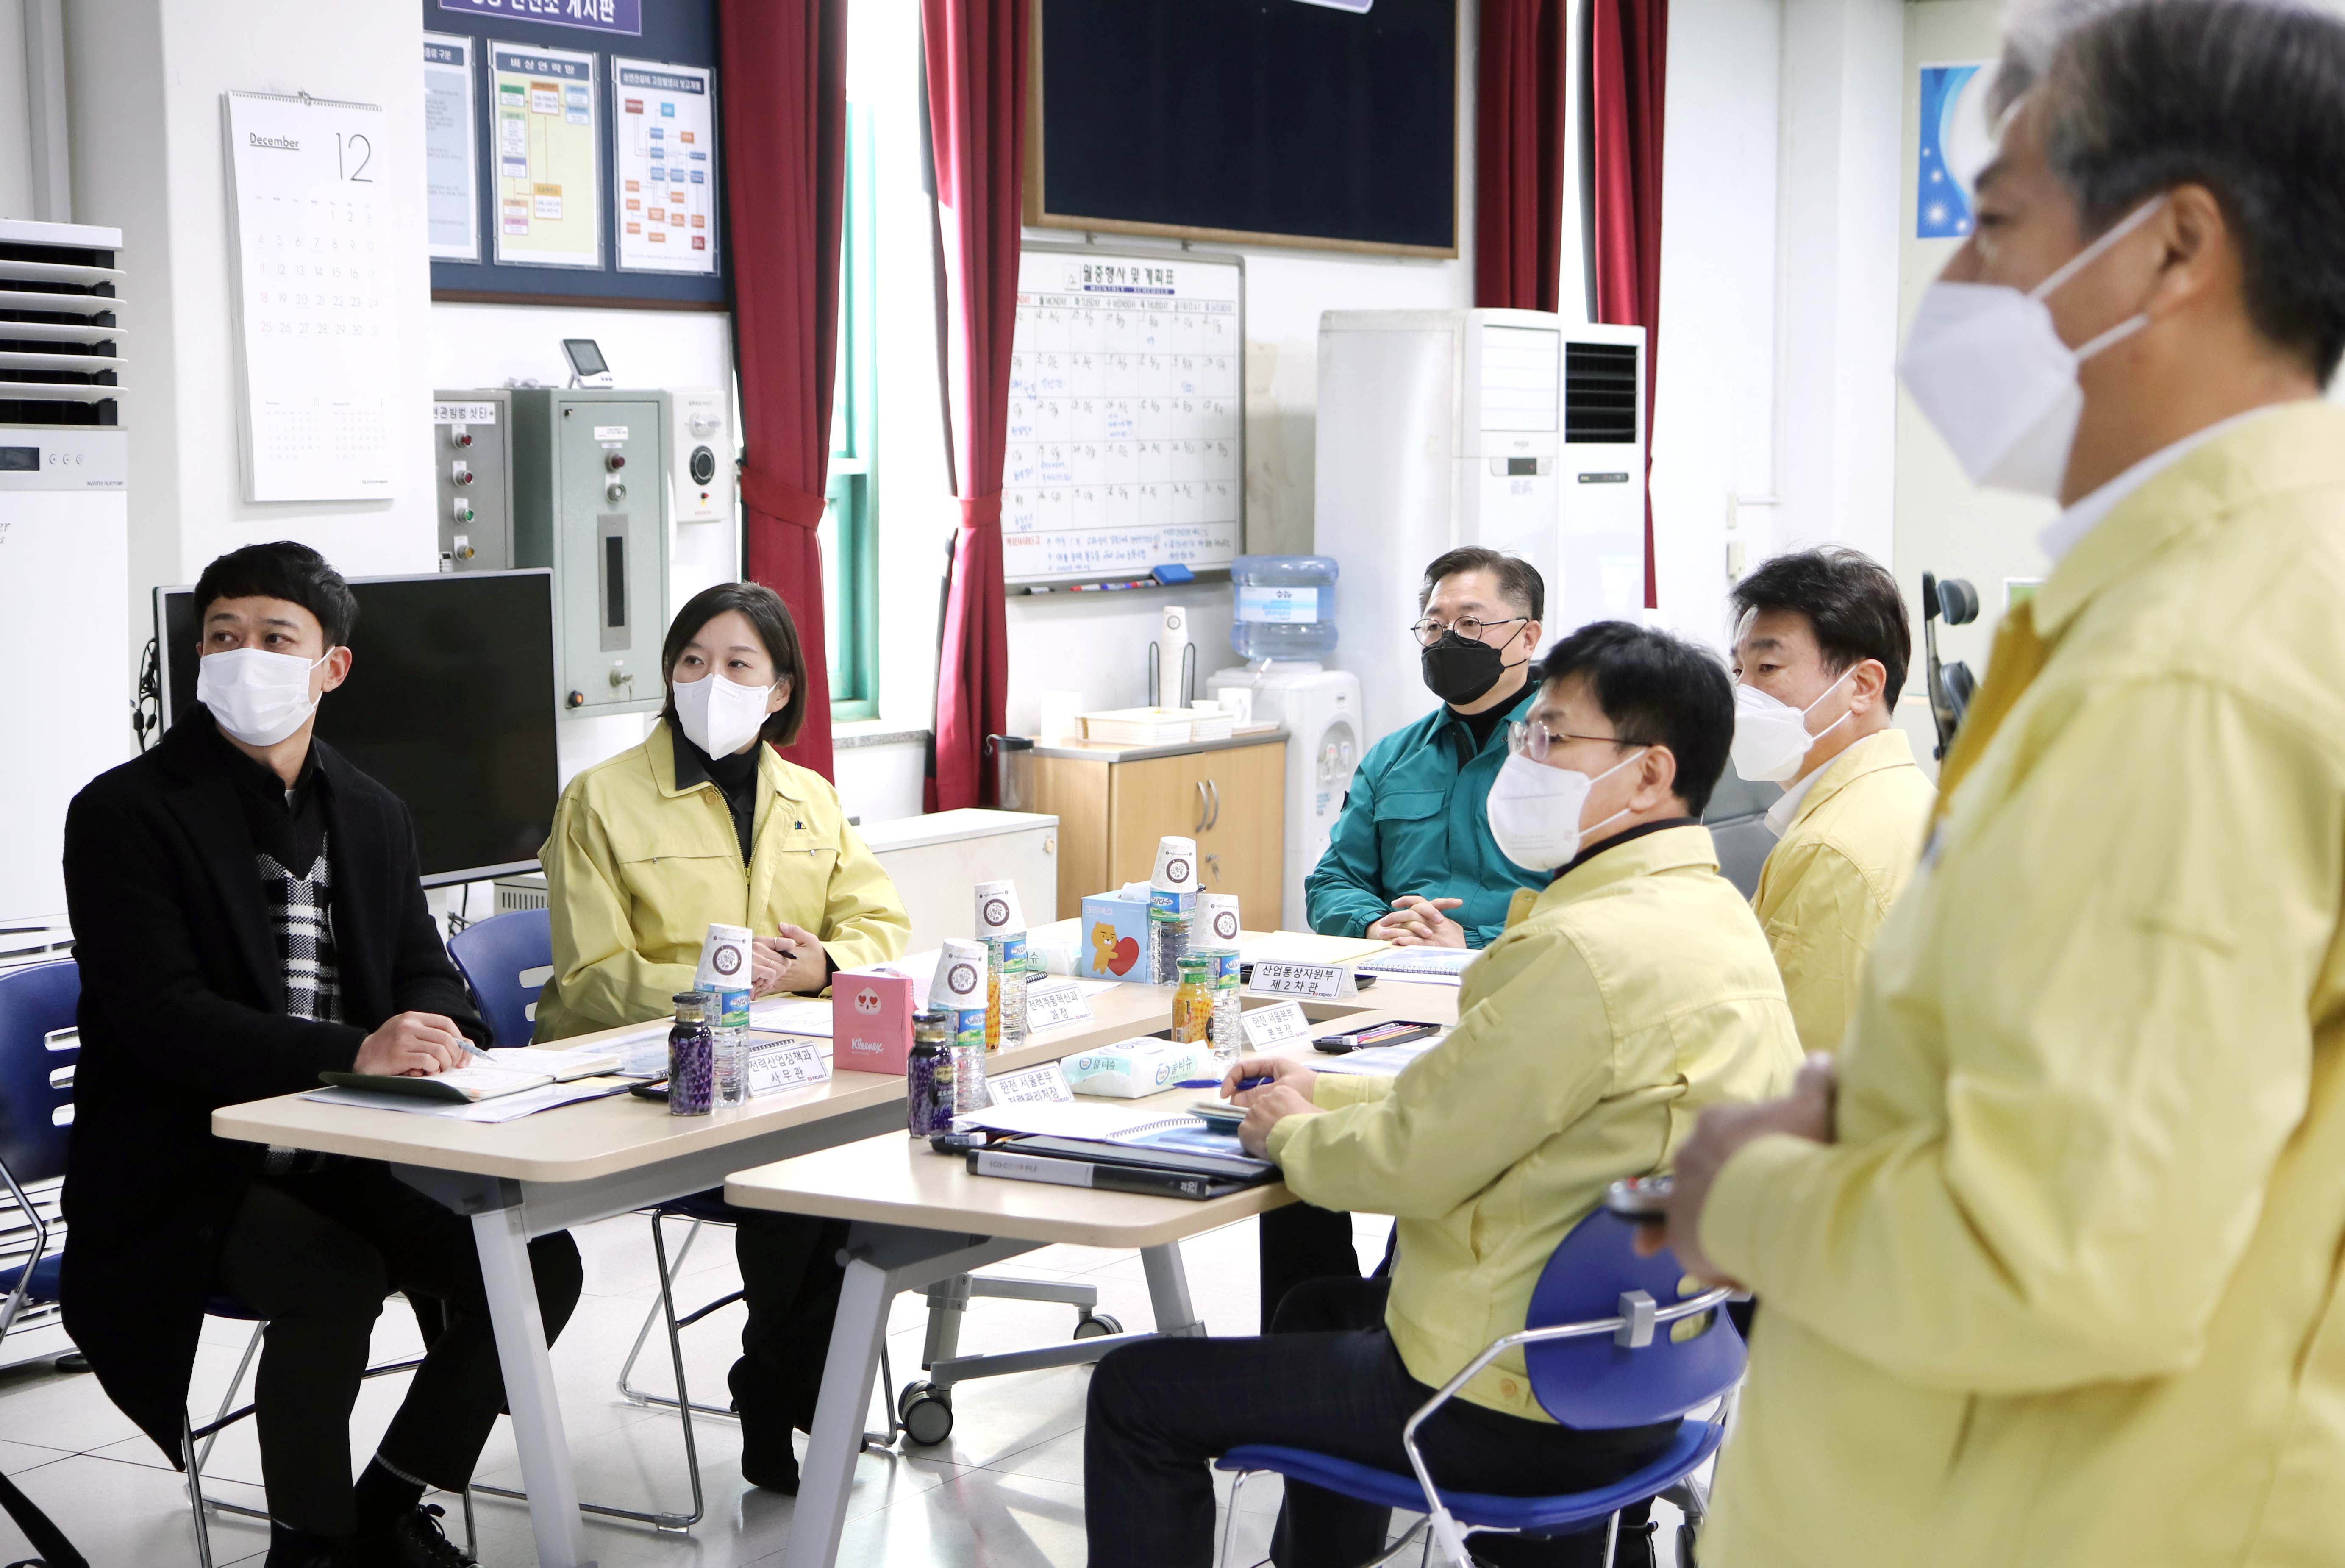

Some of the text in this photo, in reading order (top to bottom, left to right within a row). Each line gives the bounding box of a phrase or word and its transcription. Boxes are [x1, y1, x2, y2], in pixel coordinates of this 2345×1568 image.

[439, 49, 452, 61] 구분
[249, 132, 299, 147] December
[336, 133, 372, 182] 12
[1084, 264, 1173, 285] 월중행사 및 계획표
[1085, 905, 1114, 915] 크리넥스
[1263, 965, 1334, 981] 산업통상자원부
[1028, 990, 1078, 1011] 전력계통혁신과
[1252, 1008, 1294, 1028] 한전 서울본부
[852, 1038, 884, 1054] Kleenex
[749, 1049, 812, 1072] 전력산업정책과
[1092, 1060, 1115, 1070] 물티슈
[1171, 1056, 1192, 1075] 물티슈
[999, 1071, 1053, 1094] 한전 서울본부
